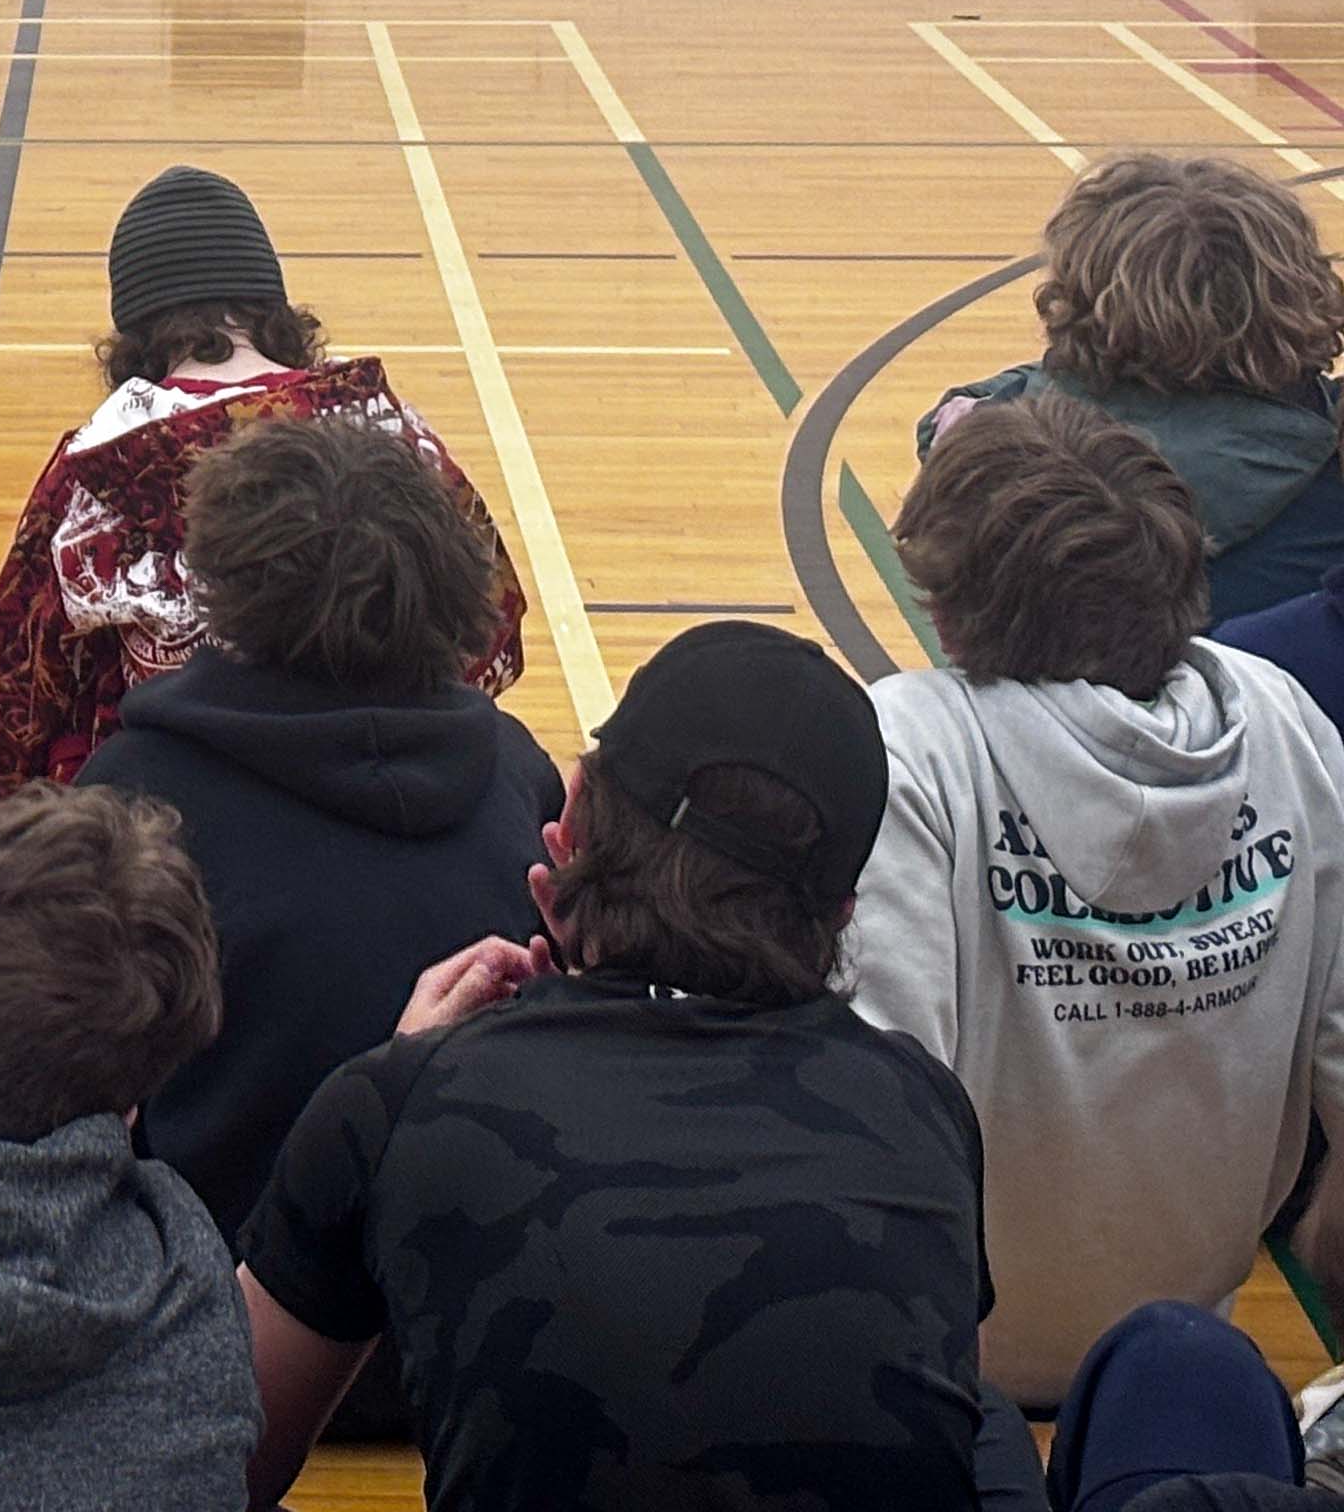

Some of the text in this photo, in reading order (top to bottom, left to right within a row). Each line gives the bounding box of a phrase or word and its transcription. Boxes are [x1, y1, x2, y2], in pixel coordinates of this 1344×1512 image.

[987, 829, 1295, 925] COLIVE
[1015, 928, 1280, 989] FEEL GOOD, BE HAP
[1030, 937, 1117, 963] WORK
[1127, 941, 1185, 963] OUT,
[1053, 1001, 1108, 1023] CALL
